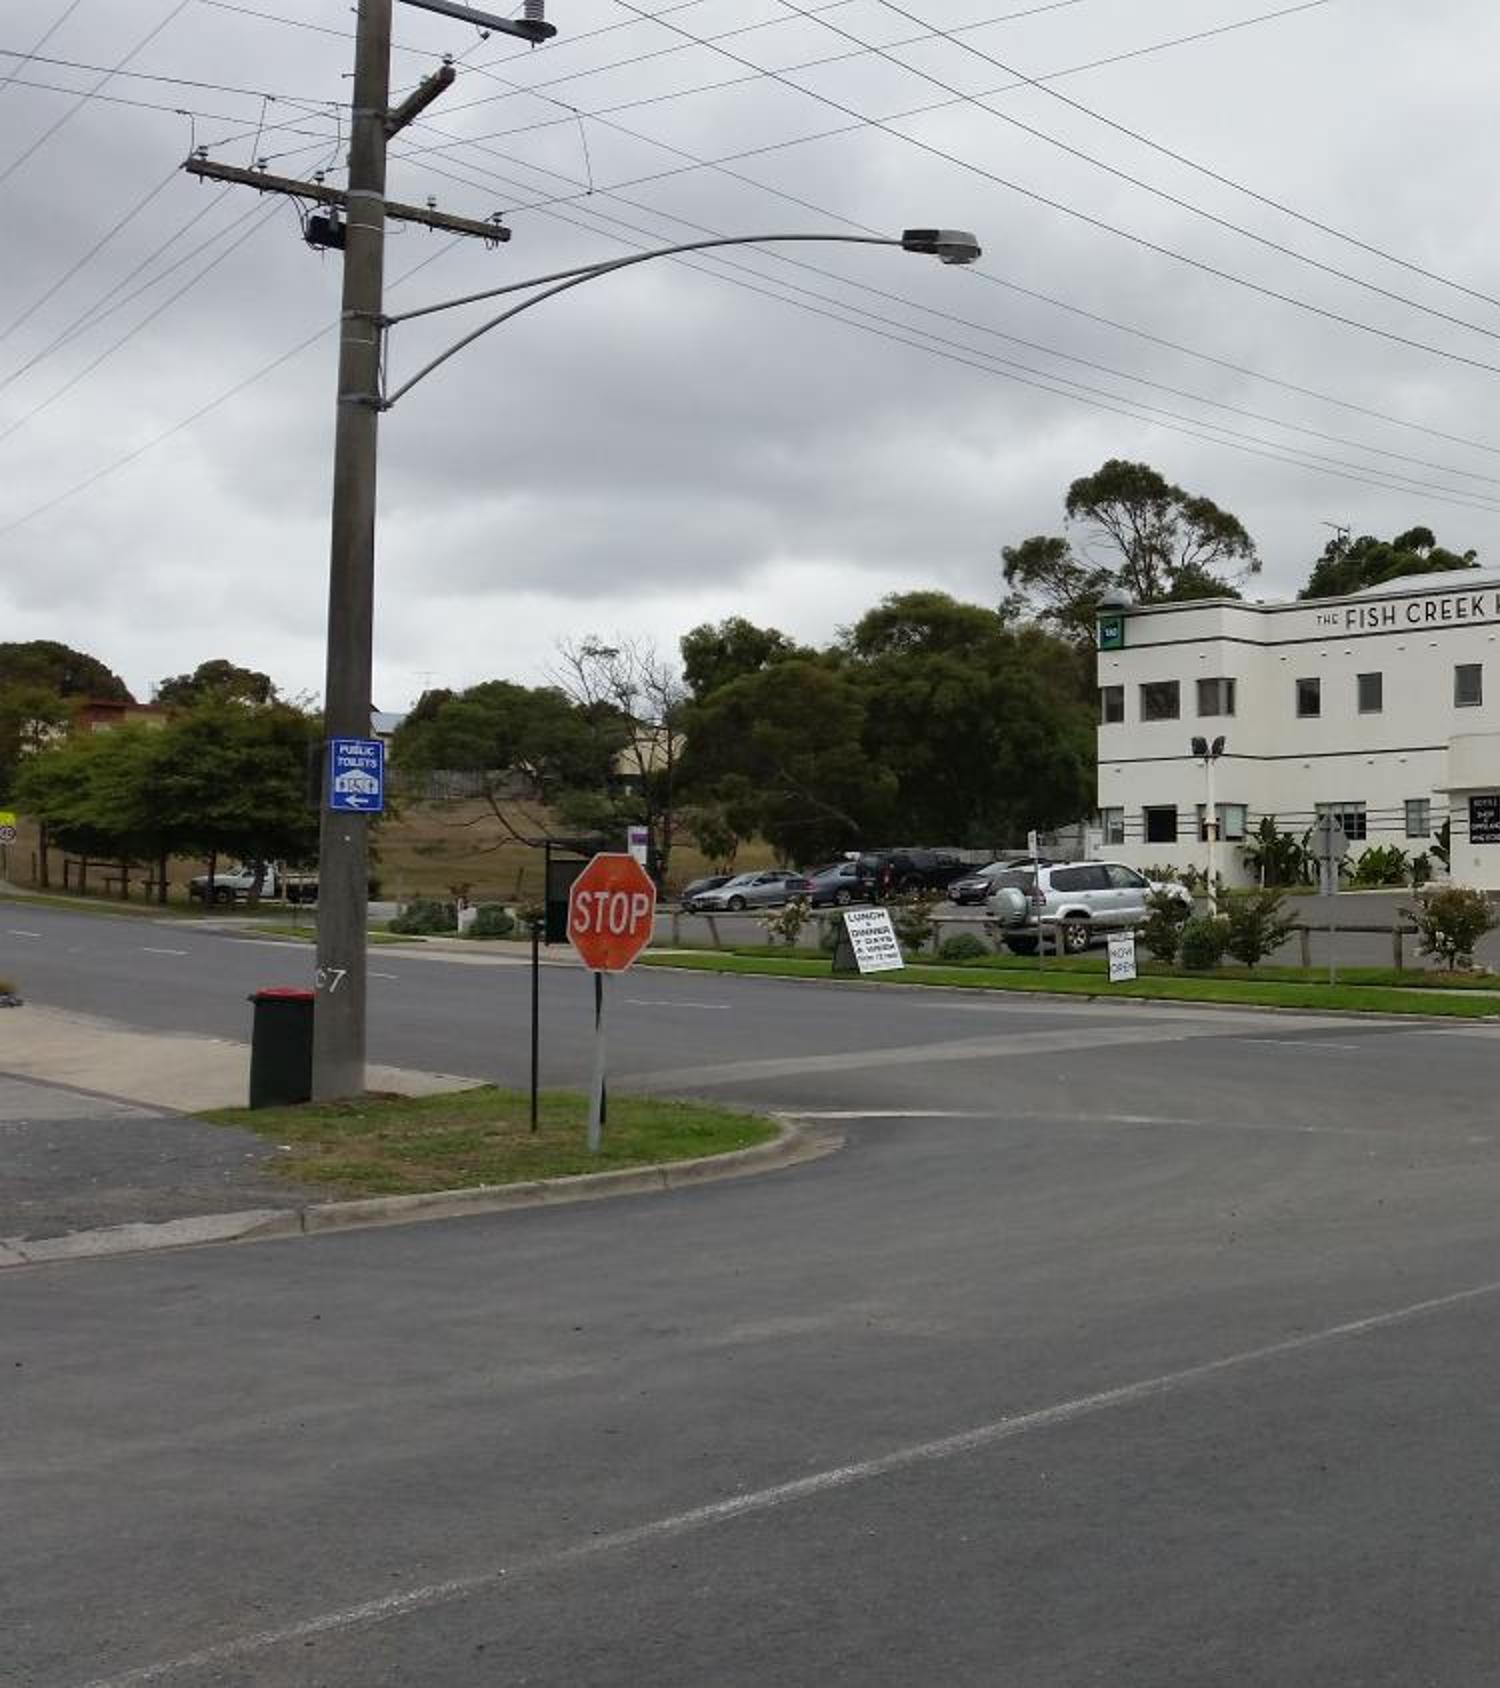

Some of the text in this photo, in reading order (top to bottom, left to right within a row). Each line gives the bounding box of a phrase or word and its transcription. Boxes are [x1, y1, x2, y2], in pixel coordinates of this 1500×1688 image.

[1316, 613, 1338, 625] THE
[1345, 604, 1396, 629] FISH
[1406, 595, 1485, 623] CREEK
[339, 744, 376, 756] PUBLIC
[337, 756, 378, 769] TOILETS
[573, 890, 650, 935] STOP
[847, 911, 885, 923] LUNCH
[850, 926, 891, 938] DINNER
